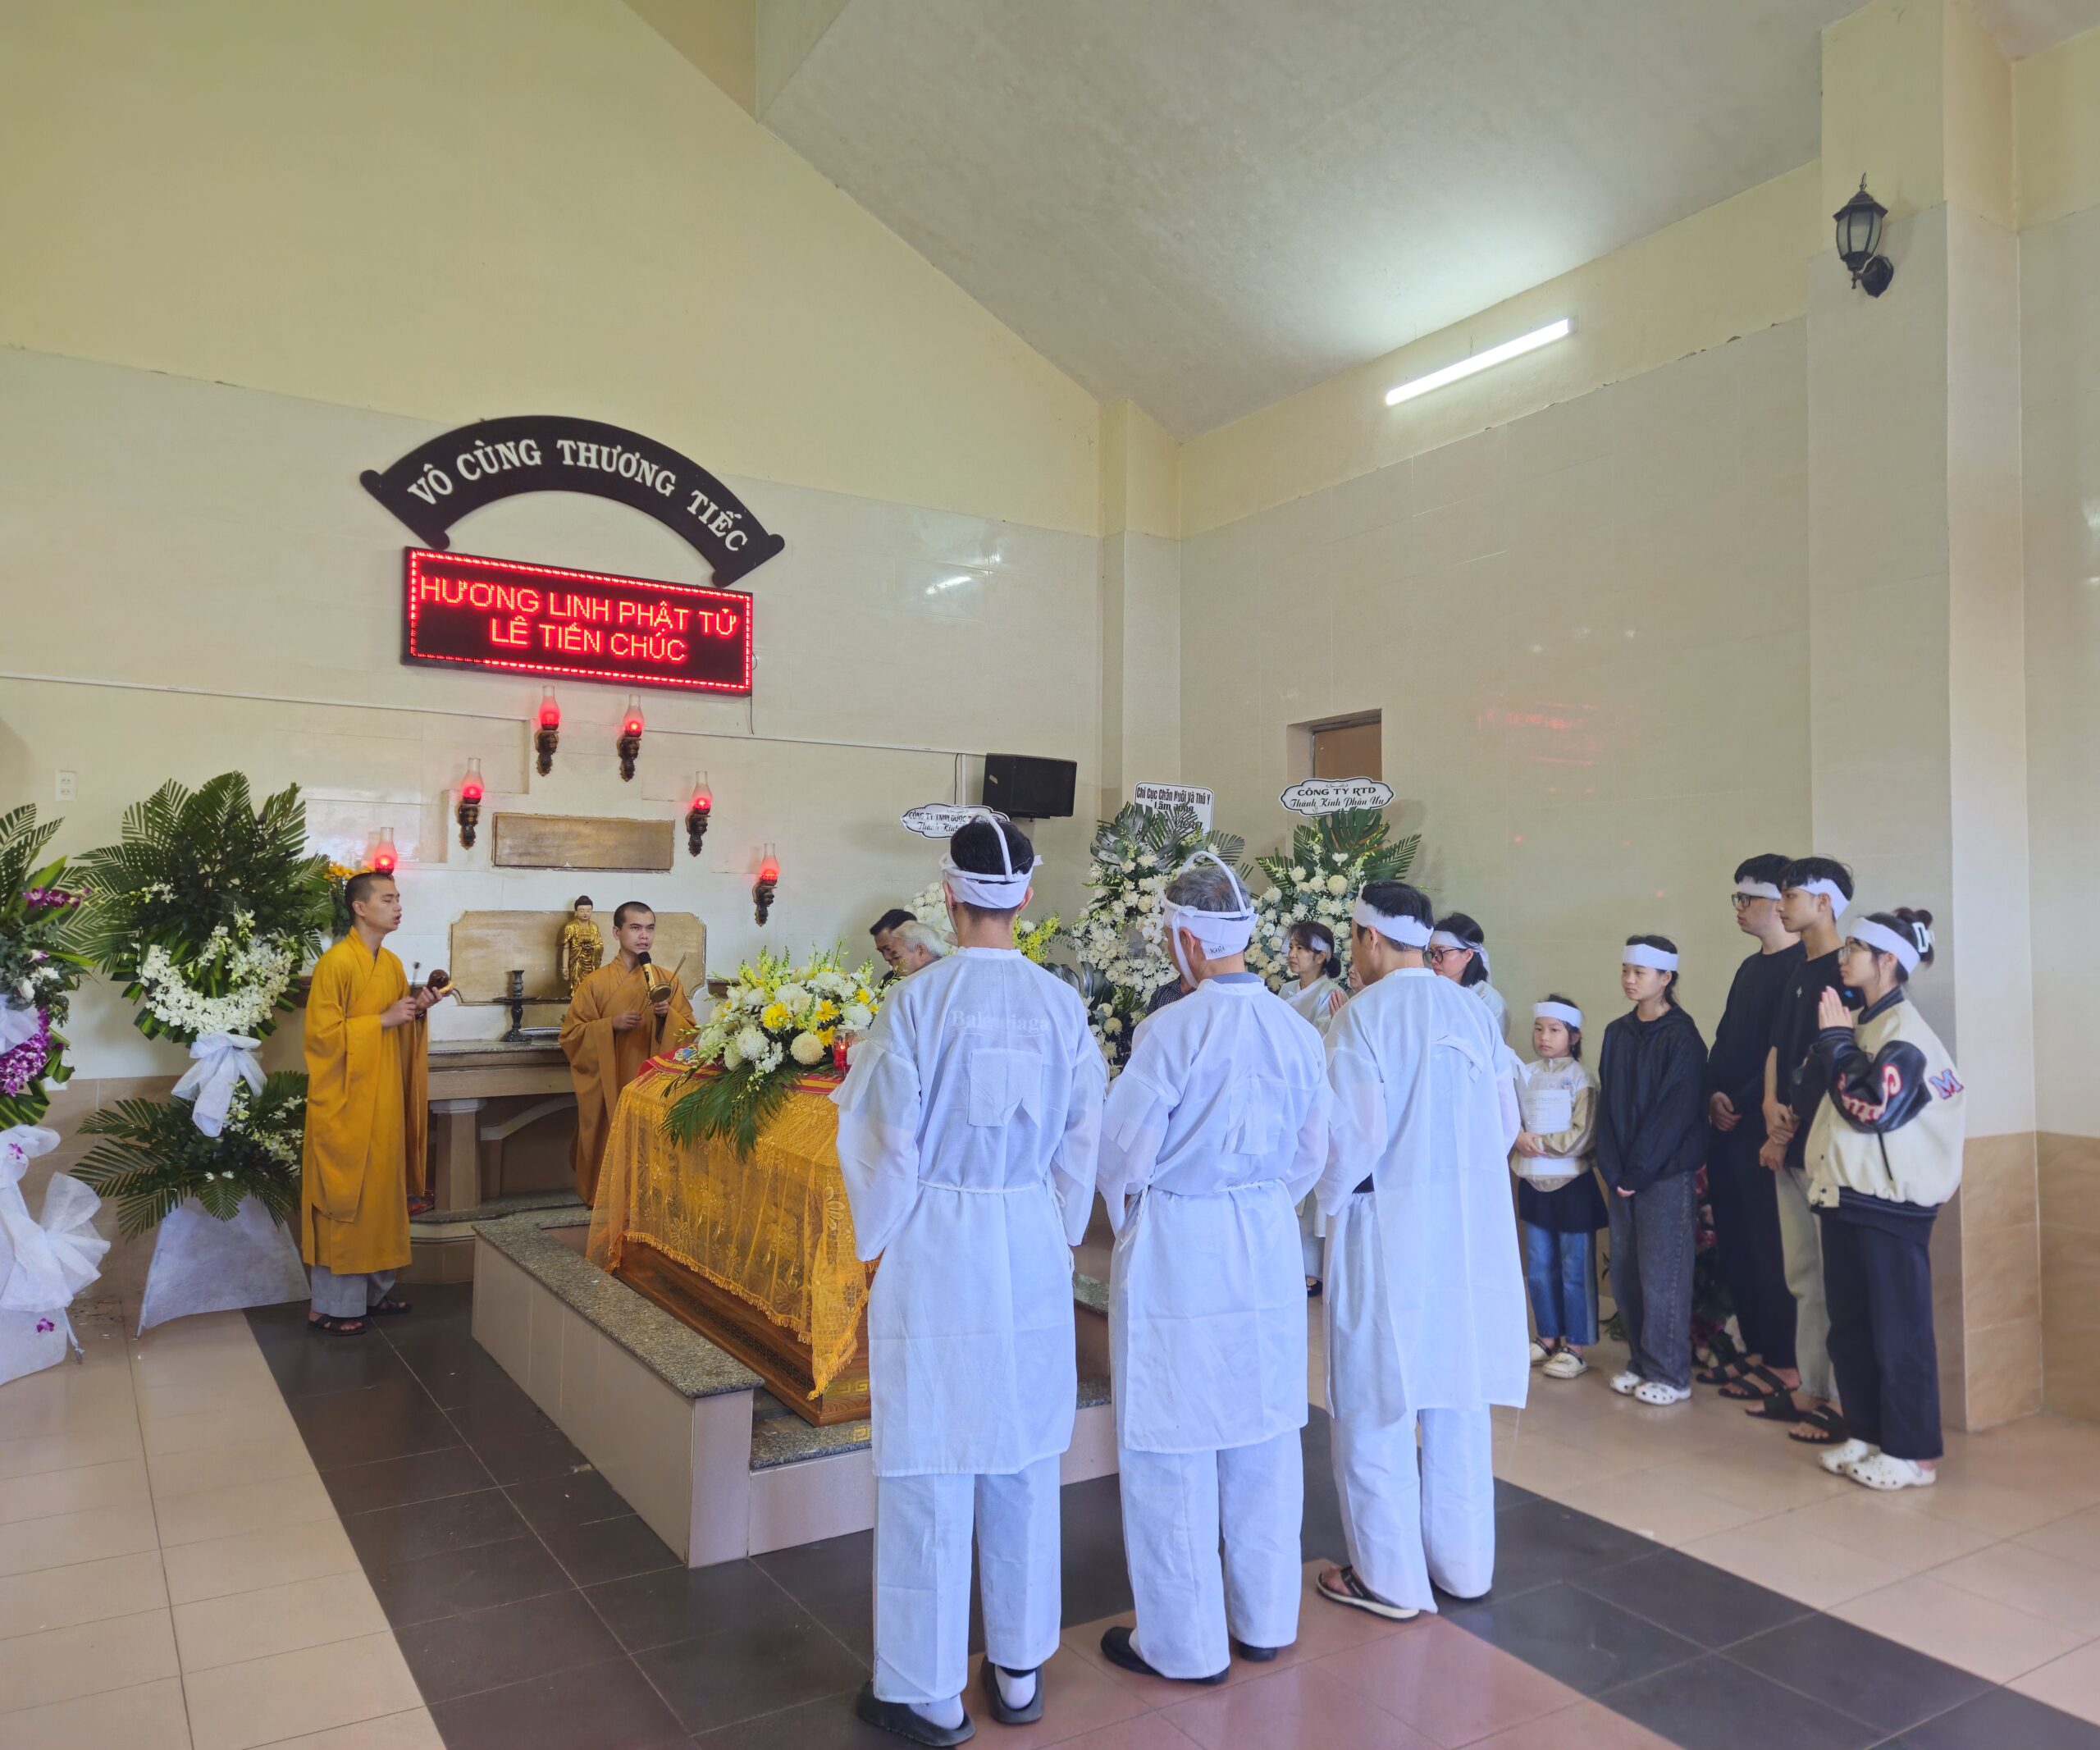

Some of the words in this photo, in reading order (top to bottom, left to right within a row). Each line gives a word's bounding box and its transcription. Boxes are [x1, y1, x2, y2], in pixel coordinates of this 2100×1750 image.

[407, 463, 453, 505] VÔ
[456, 439, 542, 481] CÙNG
[556, 439, 677, 497] THƯƠNG
[687, 490, 748, 551] TIẾC
[421, 576, 540, 613] HƯƠNG
[550, 592, 609, 622] LINH
[619, 601, 689, 632] PHẬT
[699, 608, 737, 635] TỬ
[491, 615, 528, 645] LÊ
[538, 622, 600, 653] TIẾN
[610, 632, 685, 661] CHÚC
[1136, 787, 1146, 798] Chi
[1147, 788, 1157, 802] Cục
[1158, 788, 1173, 802] Chăn
[1174, 789, 1187, 802] Nuôi
[1195, 793, 1206, 804] Thú
[1207, 793, 1211, 805] Y
[1297, 787, 1330, 797] CÔNG
[1352, 787, 1376, 797] RTD
[908, 810, 924, 820] CÔNG
[936, 813, 950, 821] TNHH
[1154, 801, 1171, 811] Lâm
[1929, 1068, 1964, 1100] M
